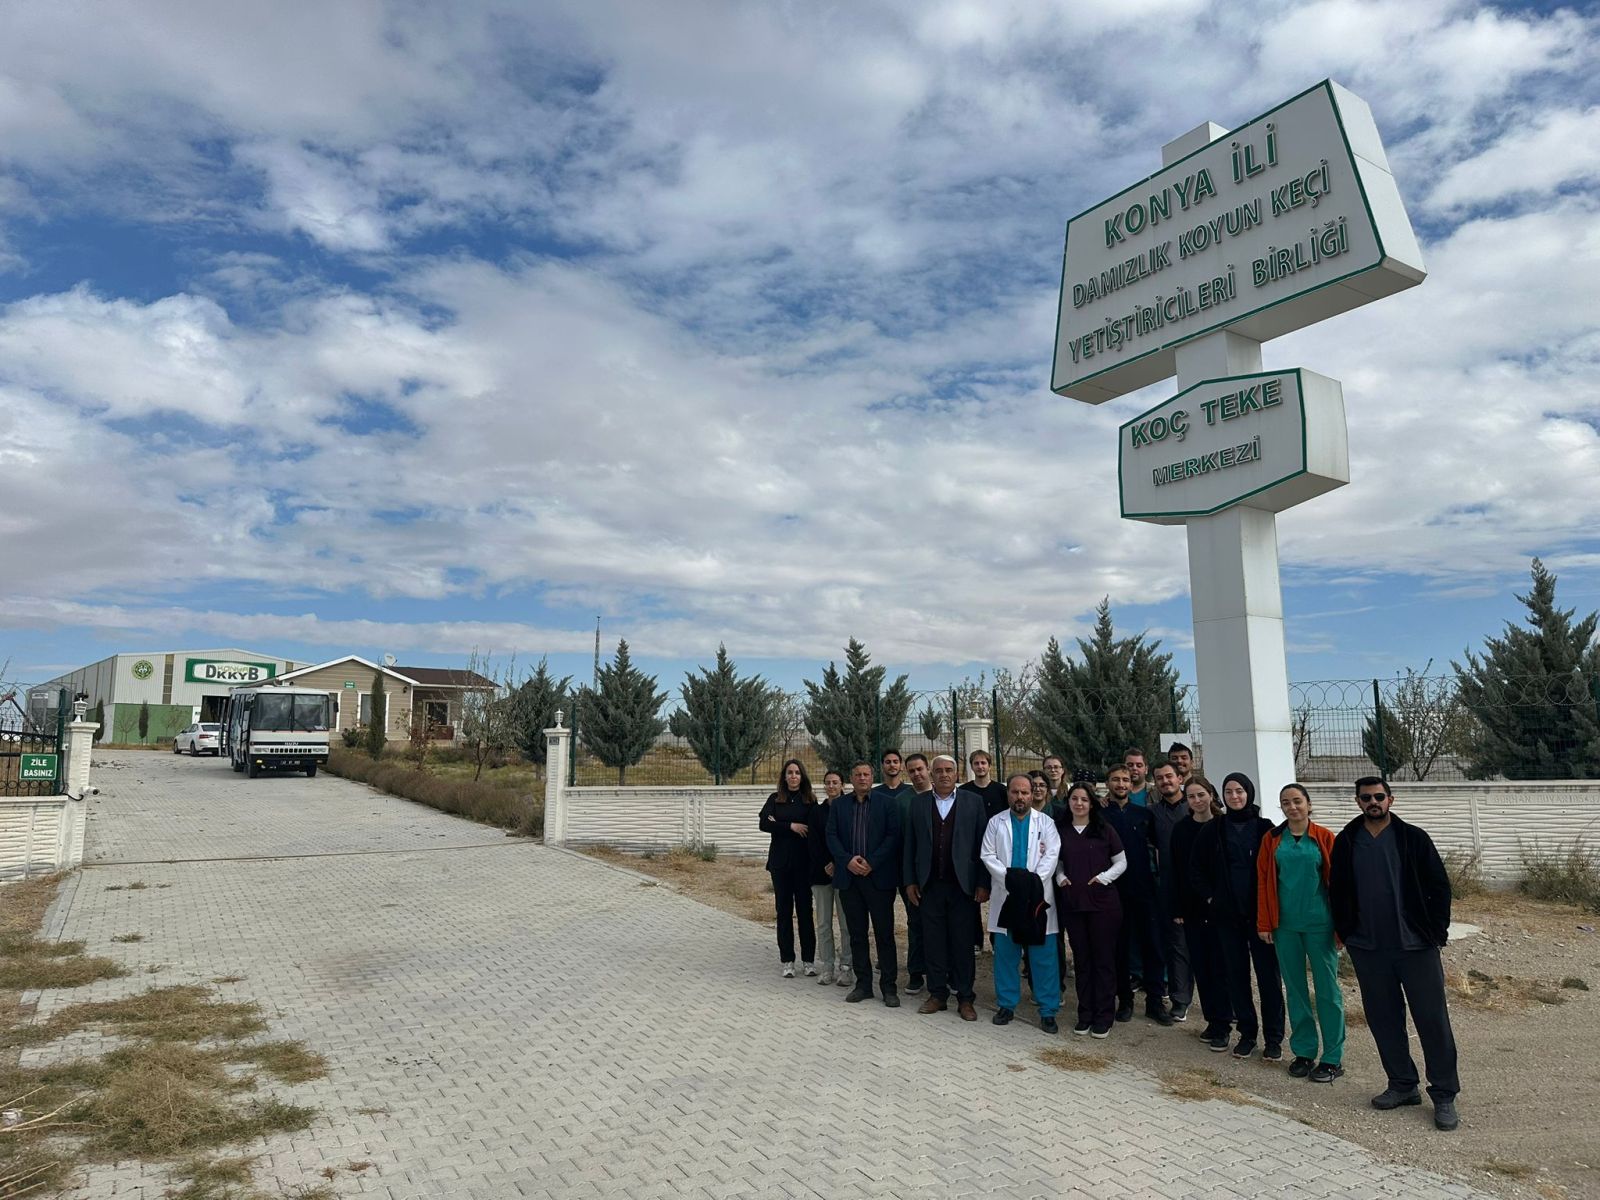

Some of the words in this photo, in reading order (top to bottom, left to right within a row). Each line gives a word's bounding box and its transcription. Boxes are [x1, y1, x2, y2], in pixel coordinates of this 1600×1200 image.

[1104, 167, 1217, 249] KONYA
[1230, 122, 1279, 184] İLİ
[1072, 241, 1172, 309] DAMIZLIK
[1178, 198, 1262, 259] KOYUN
[1270, 158, 1331, 217] KEÇİ
[1068, 264, 1236, 364] YETİŞTİRİCİLERİ
[1251, 216, 1350, 288] BİRLİĞİ
[1131, 410, 1190, 448] KOÇ
[1200, 378, 1283, 425] TEKE
[1152, 435, 1262, 487] MERKEZİ
[23, 769, 53, 777] BASINIZ
[30, 757, 48, 767] ZİLE
